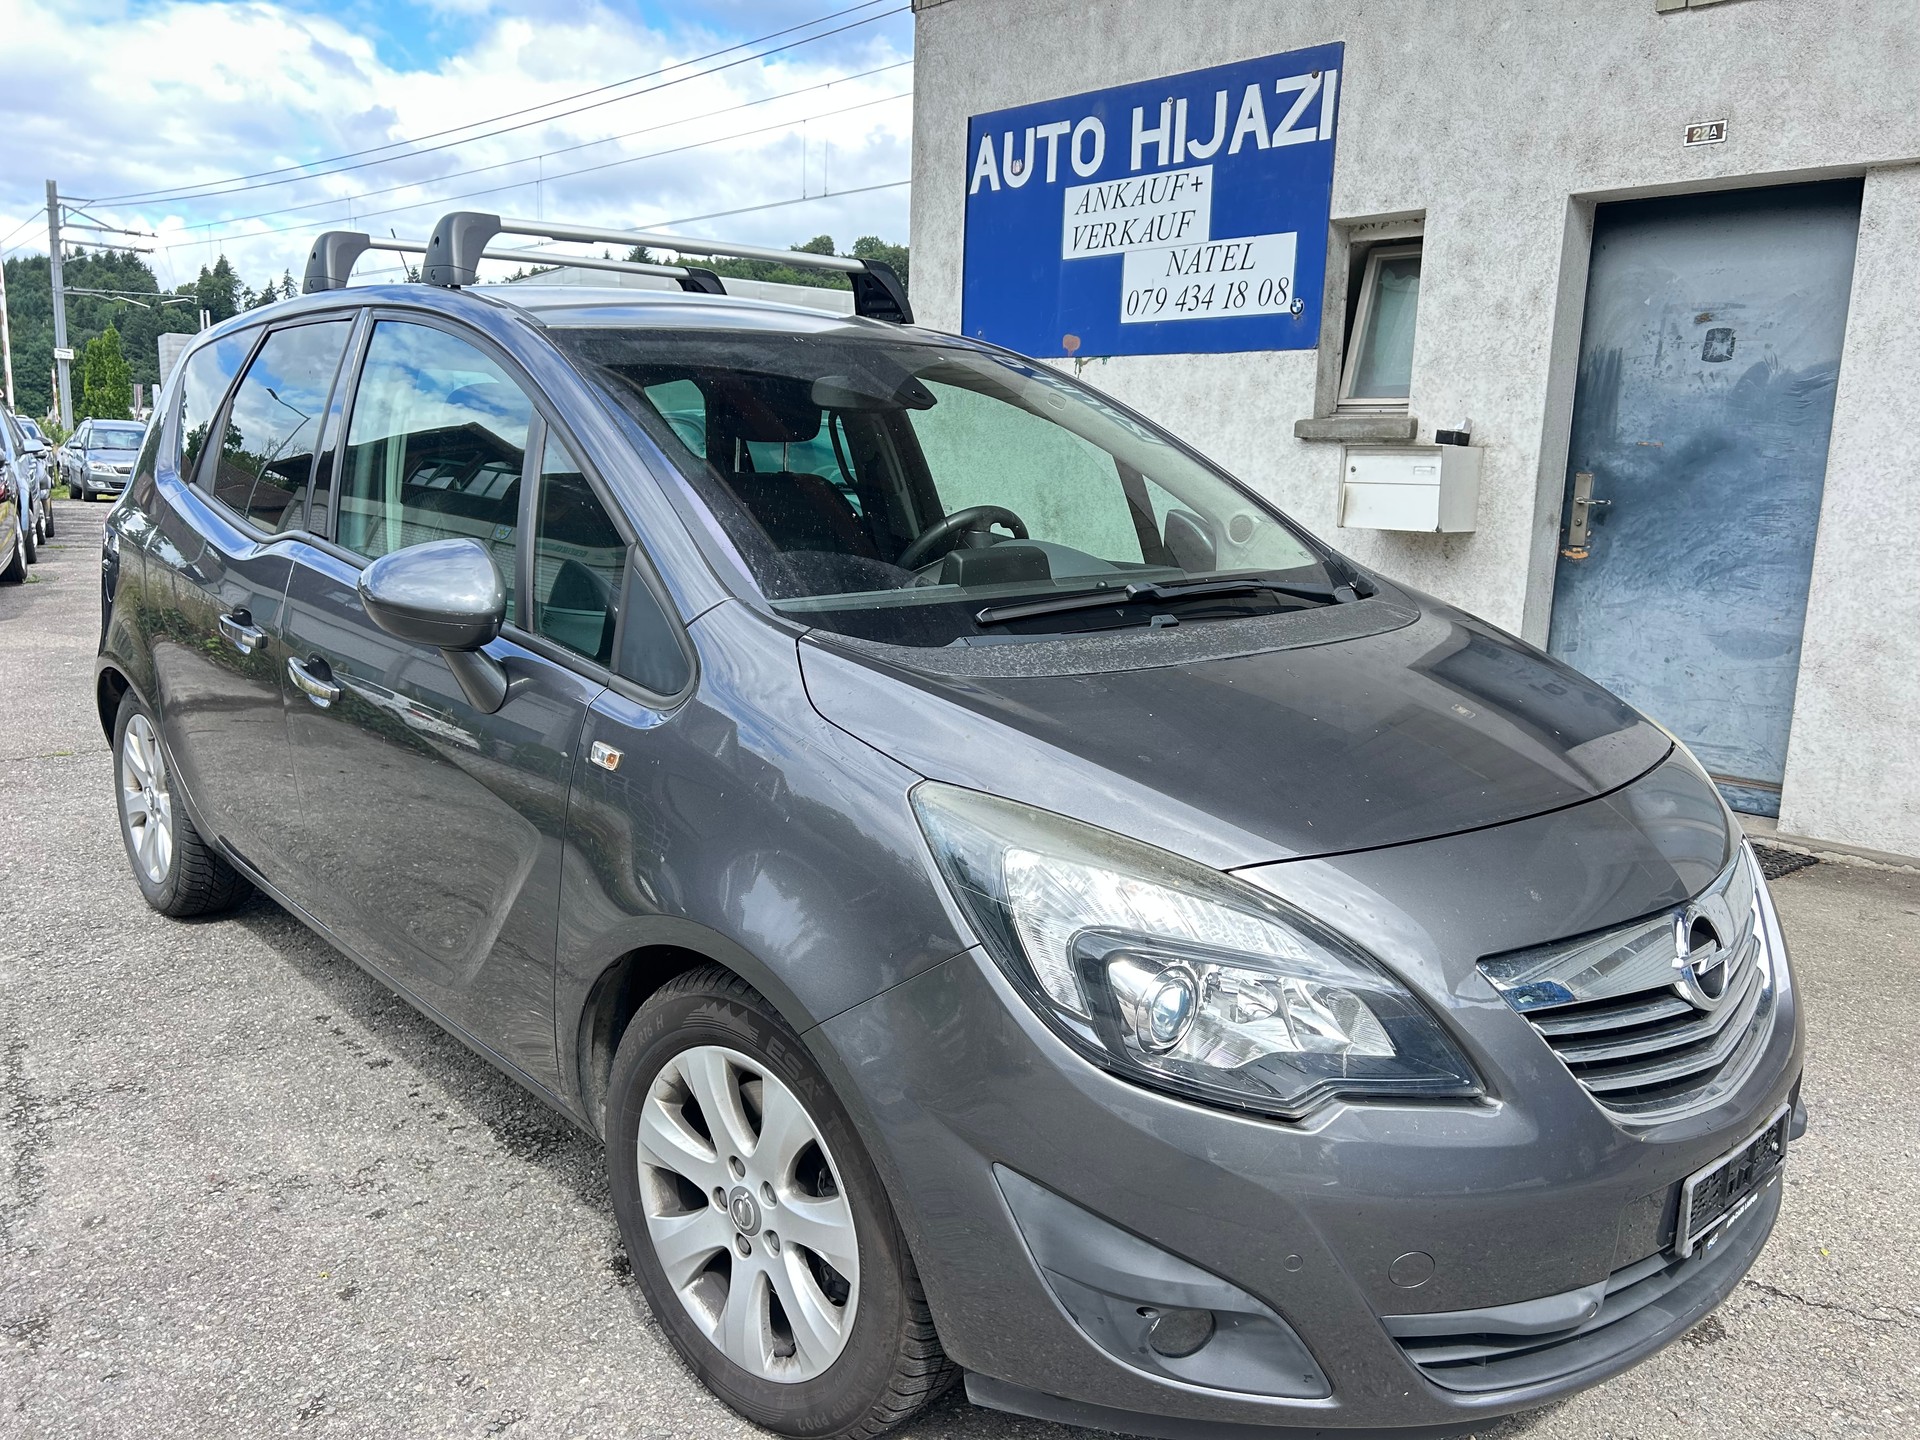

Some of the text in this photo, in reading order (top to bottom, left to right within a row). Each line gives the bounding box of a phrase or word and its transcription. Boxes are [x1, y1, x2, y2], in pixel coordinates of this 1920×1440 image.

[969, 69, 1337, 195] AUTO HIJAZI
[1071, 209, 1196, 251] VERKAUF
[1165, 242, 1256, 277] NATEL
[1126, 276, 1290, 316] 079 434 18 08
